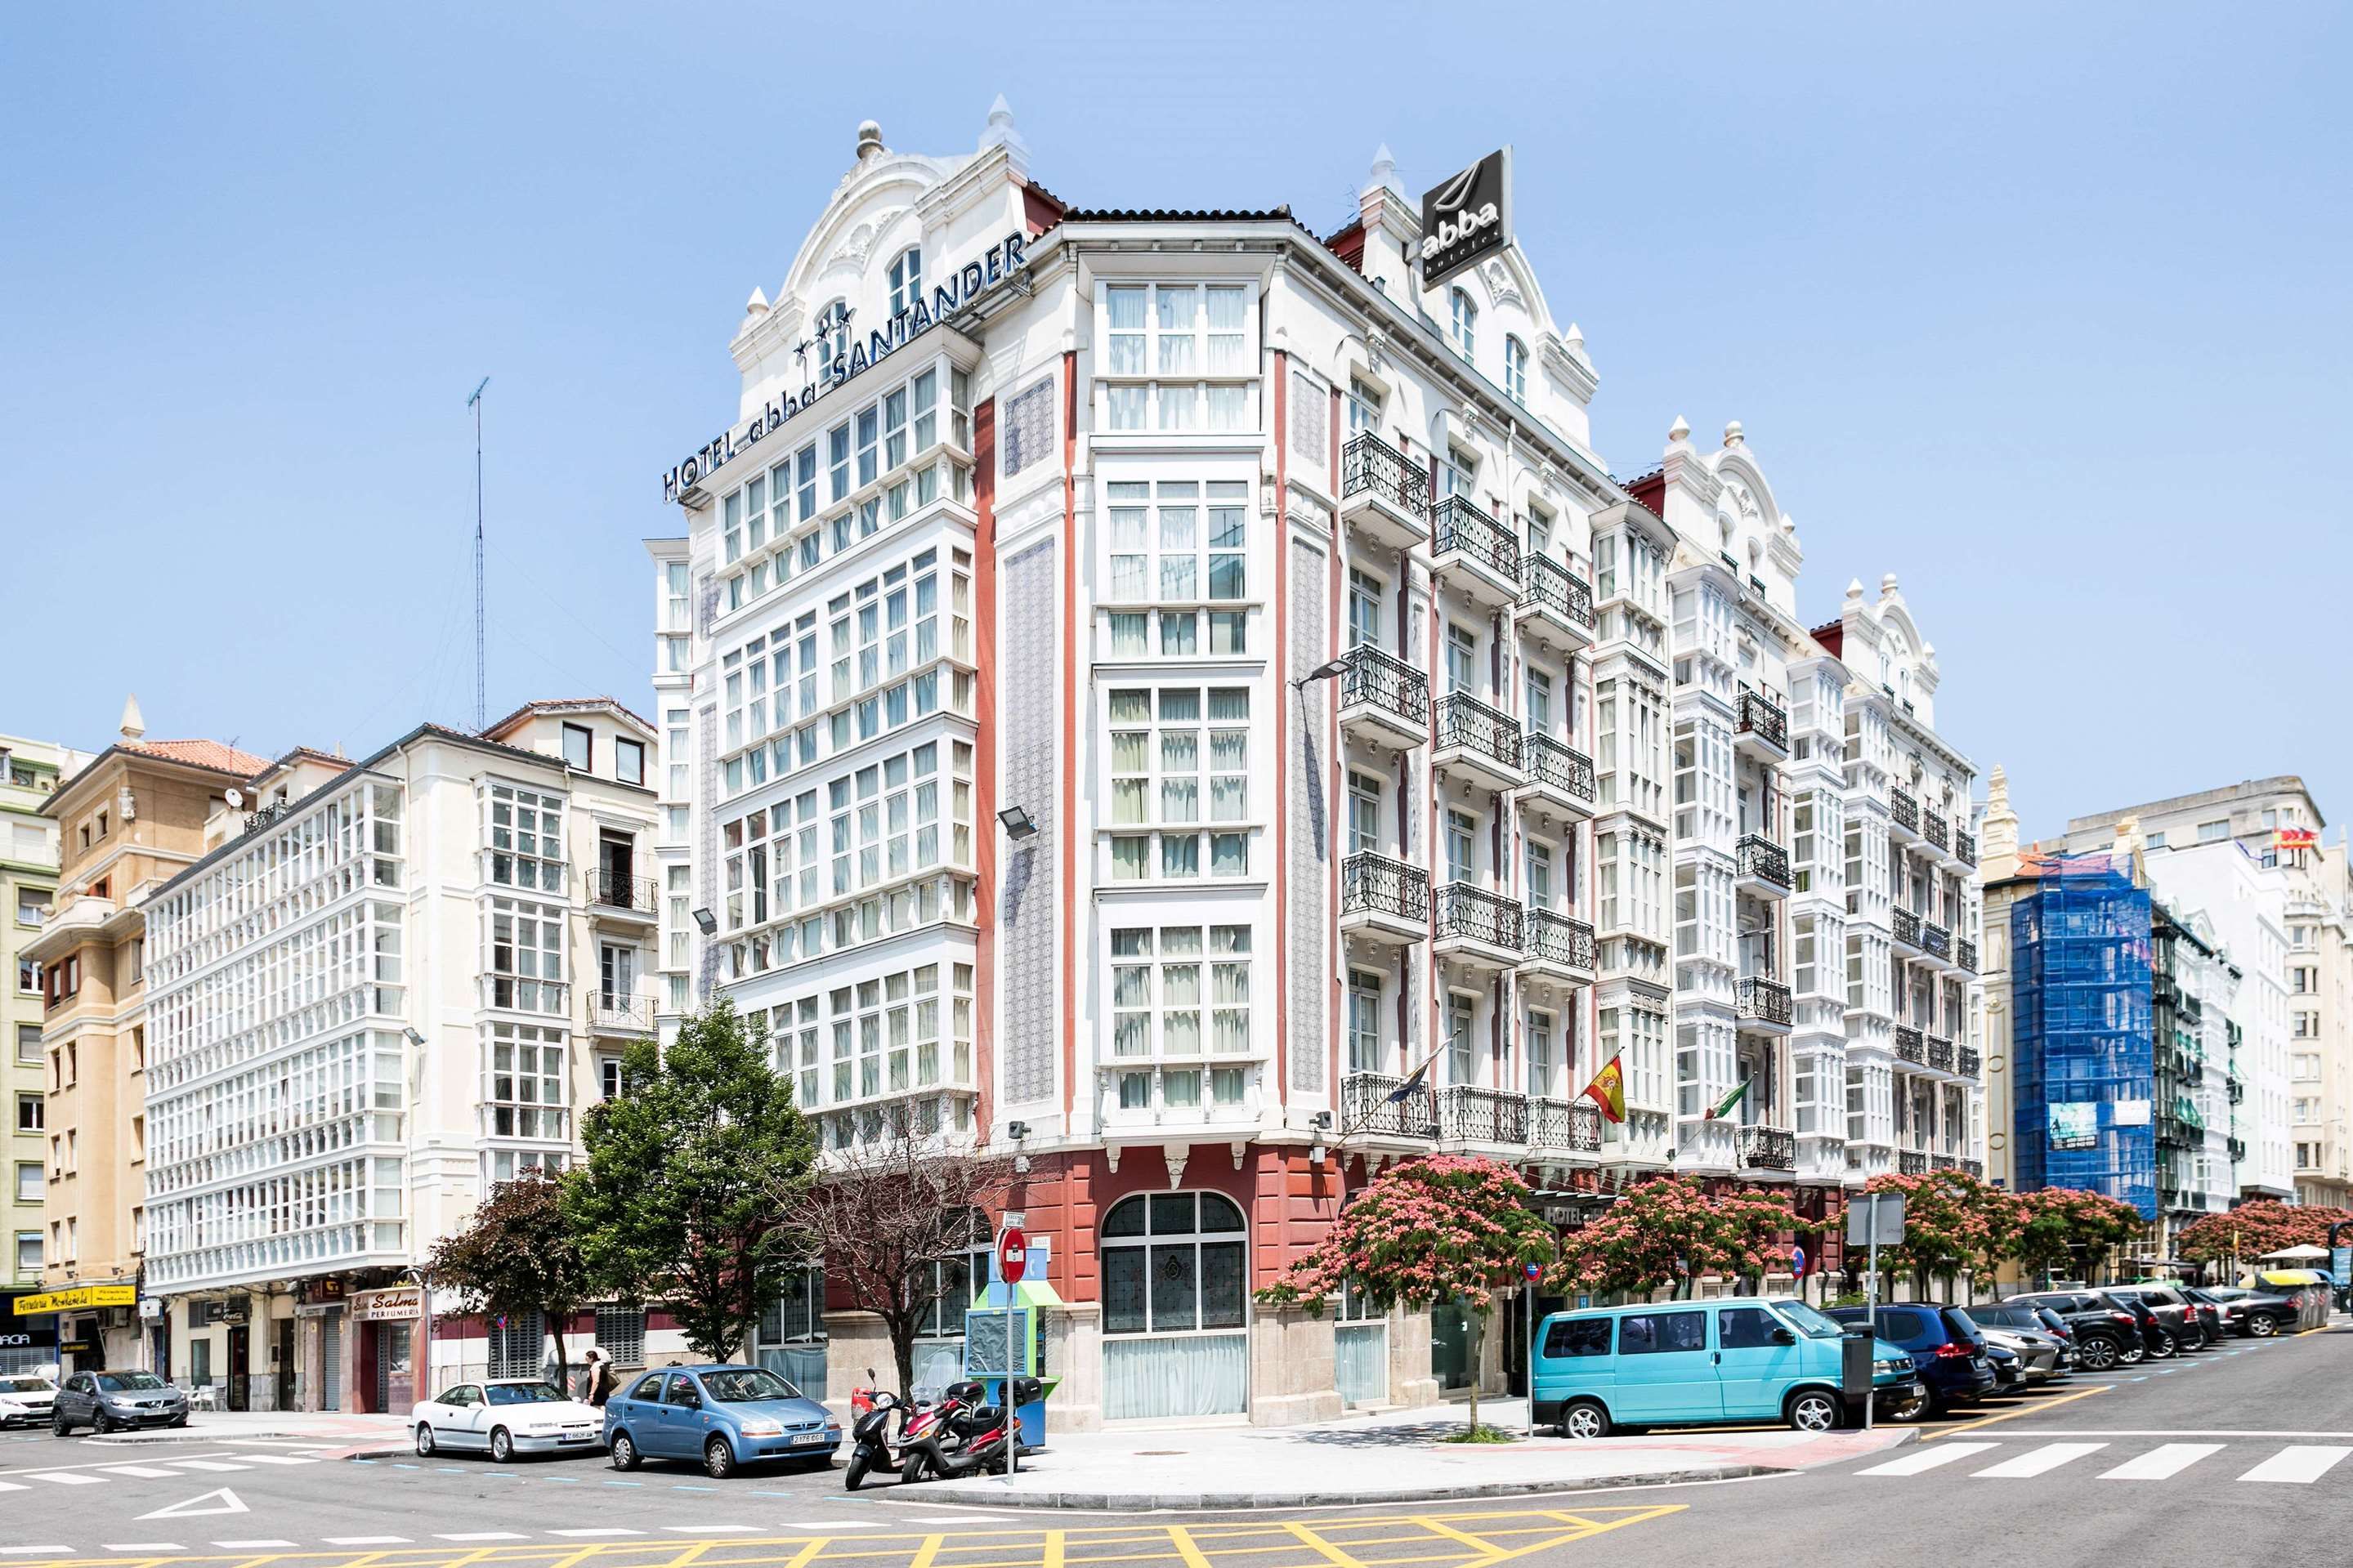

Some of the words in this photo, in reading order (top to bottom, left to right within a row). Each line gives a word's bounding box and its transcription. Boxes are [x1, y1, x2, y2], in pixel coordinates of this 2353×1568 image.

[1421, 202, 1499, 260] abba
[1426, 230, 1498, 275] hoteles
[662, 431, 736, 504] HOTEL
[749, 382, 816, 445] abba
[830, 229, 1029, 389] SANTANDER
[1544, 1206, 1582, 1225] HOTEL
[372, 1292, 418, 1309] Salma
[0, 1333, 30, 1345] ACIA
